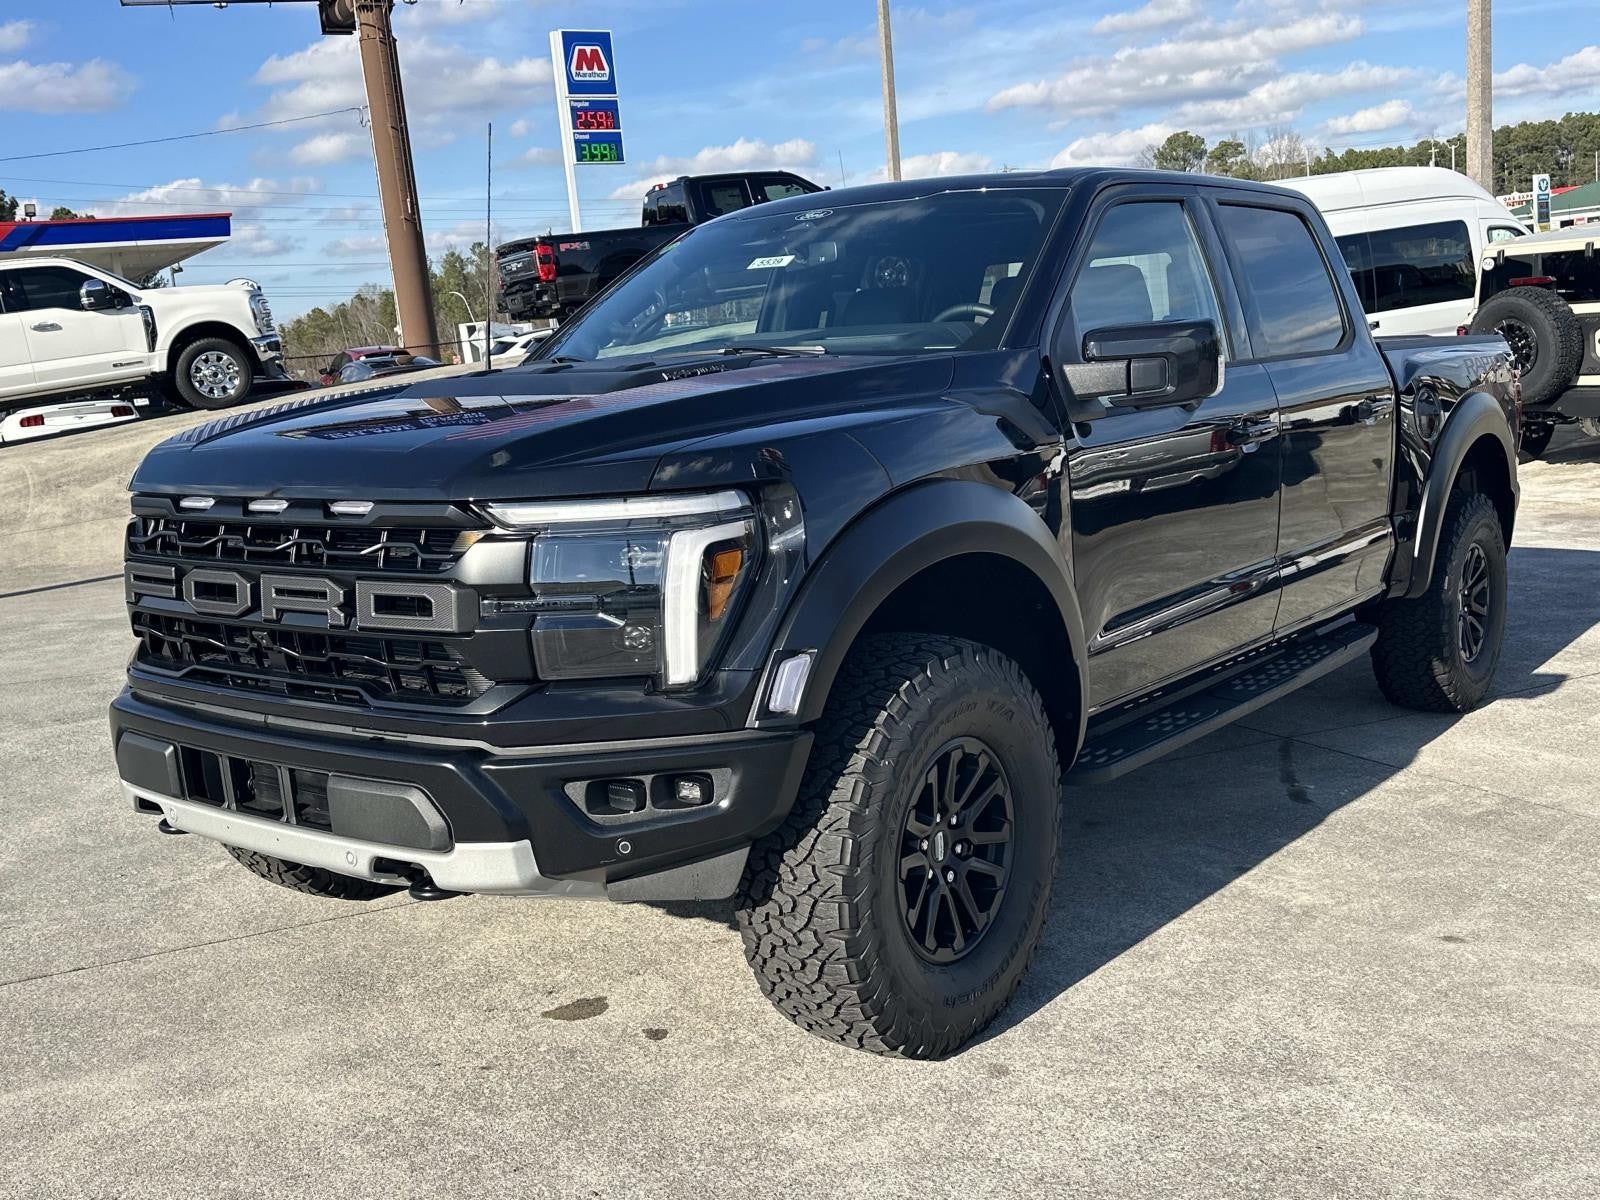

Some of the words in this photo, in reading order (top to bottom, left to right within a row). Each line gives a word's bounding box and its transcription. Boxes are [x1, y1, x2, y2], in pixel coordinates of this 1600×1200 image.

[575, 48, 606, 71] M
[570, 100, 590, 108] Regular
[559, 241, 591, 251] FX4
[125, 562, 465, 633] FORD
